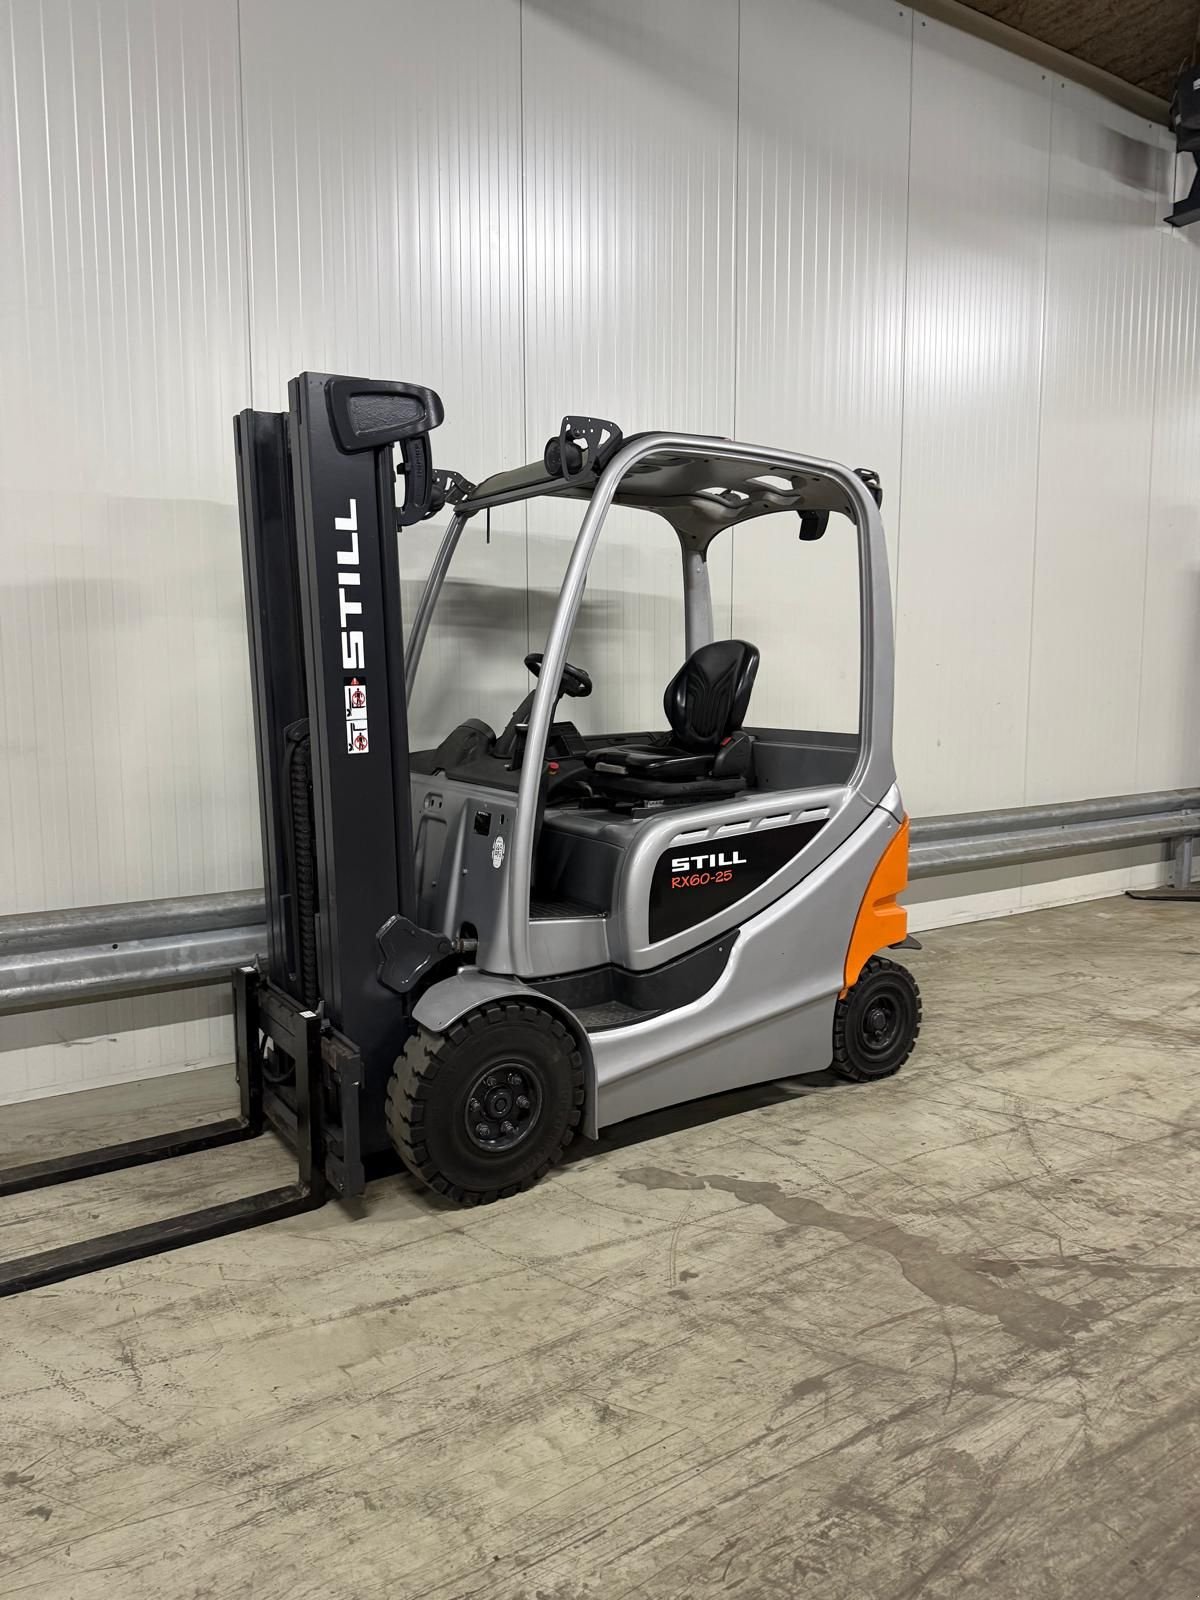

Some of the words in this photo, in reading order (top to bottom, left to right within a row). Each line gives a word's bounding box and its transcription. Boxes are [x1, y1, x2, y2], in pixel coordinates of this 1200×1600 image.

[335, 498, 365, 669] STILL
[671, 851, 747, 872] STILL
[671, 870, 733, 889] RX60-25
